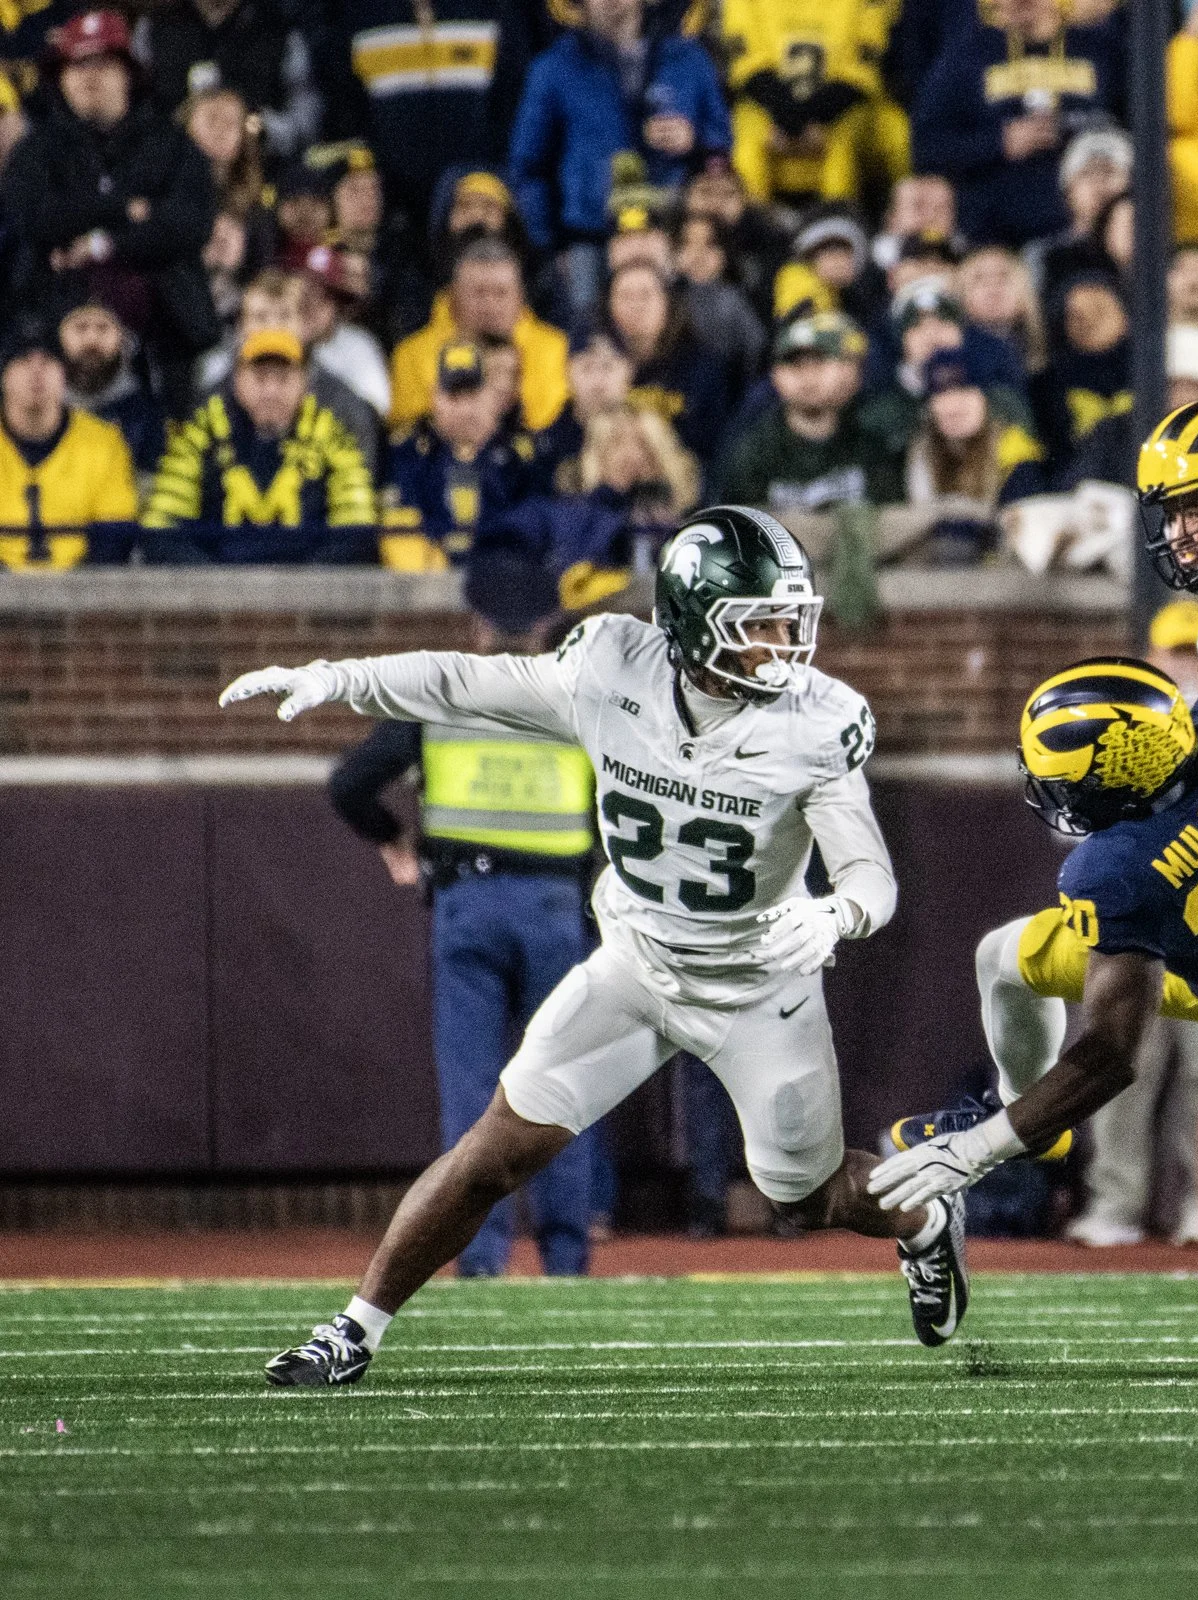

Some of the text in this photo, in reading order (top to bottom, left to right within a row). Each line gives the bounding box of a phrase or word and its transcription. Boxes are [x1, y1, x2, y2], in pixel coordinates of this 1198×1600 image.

[222, 463, 301, 528] M
[840, 705, 877, 773] 23
[601, 753, 697, 807] MICHIGAN
[701, 789, 763, 818] STATE
[601, 789, 757, 913] 23
